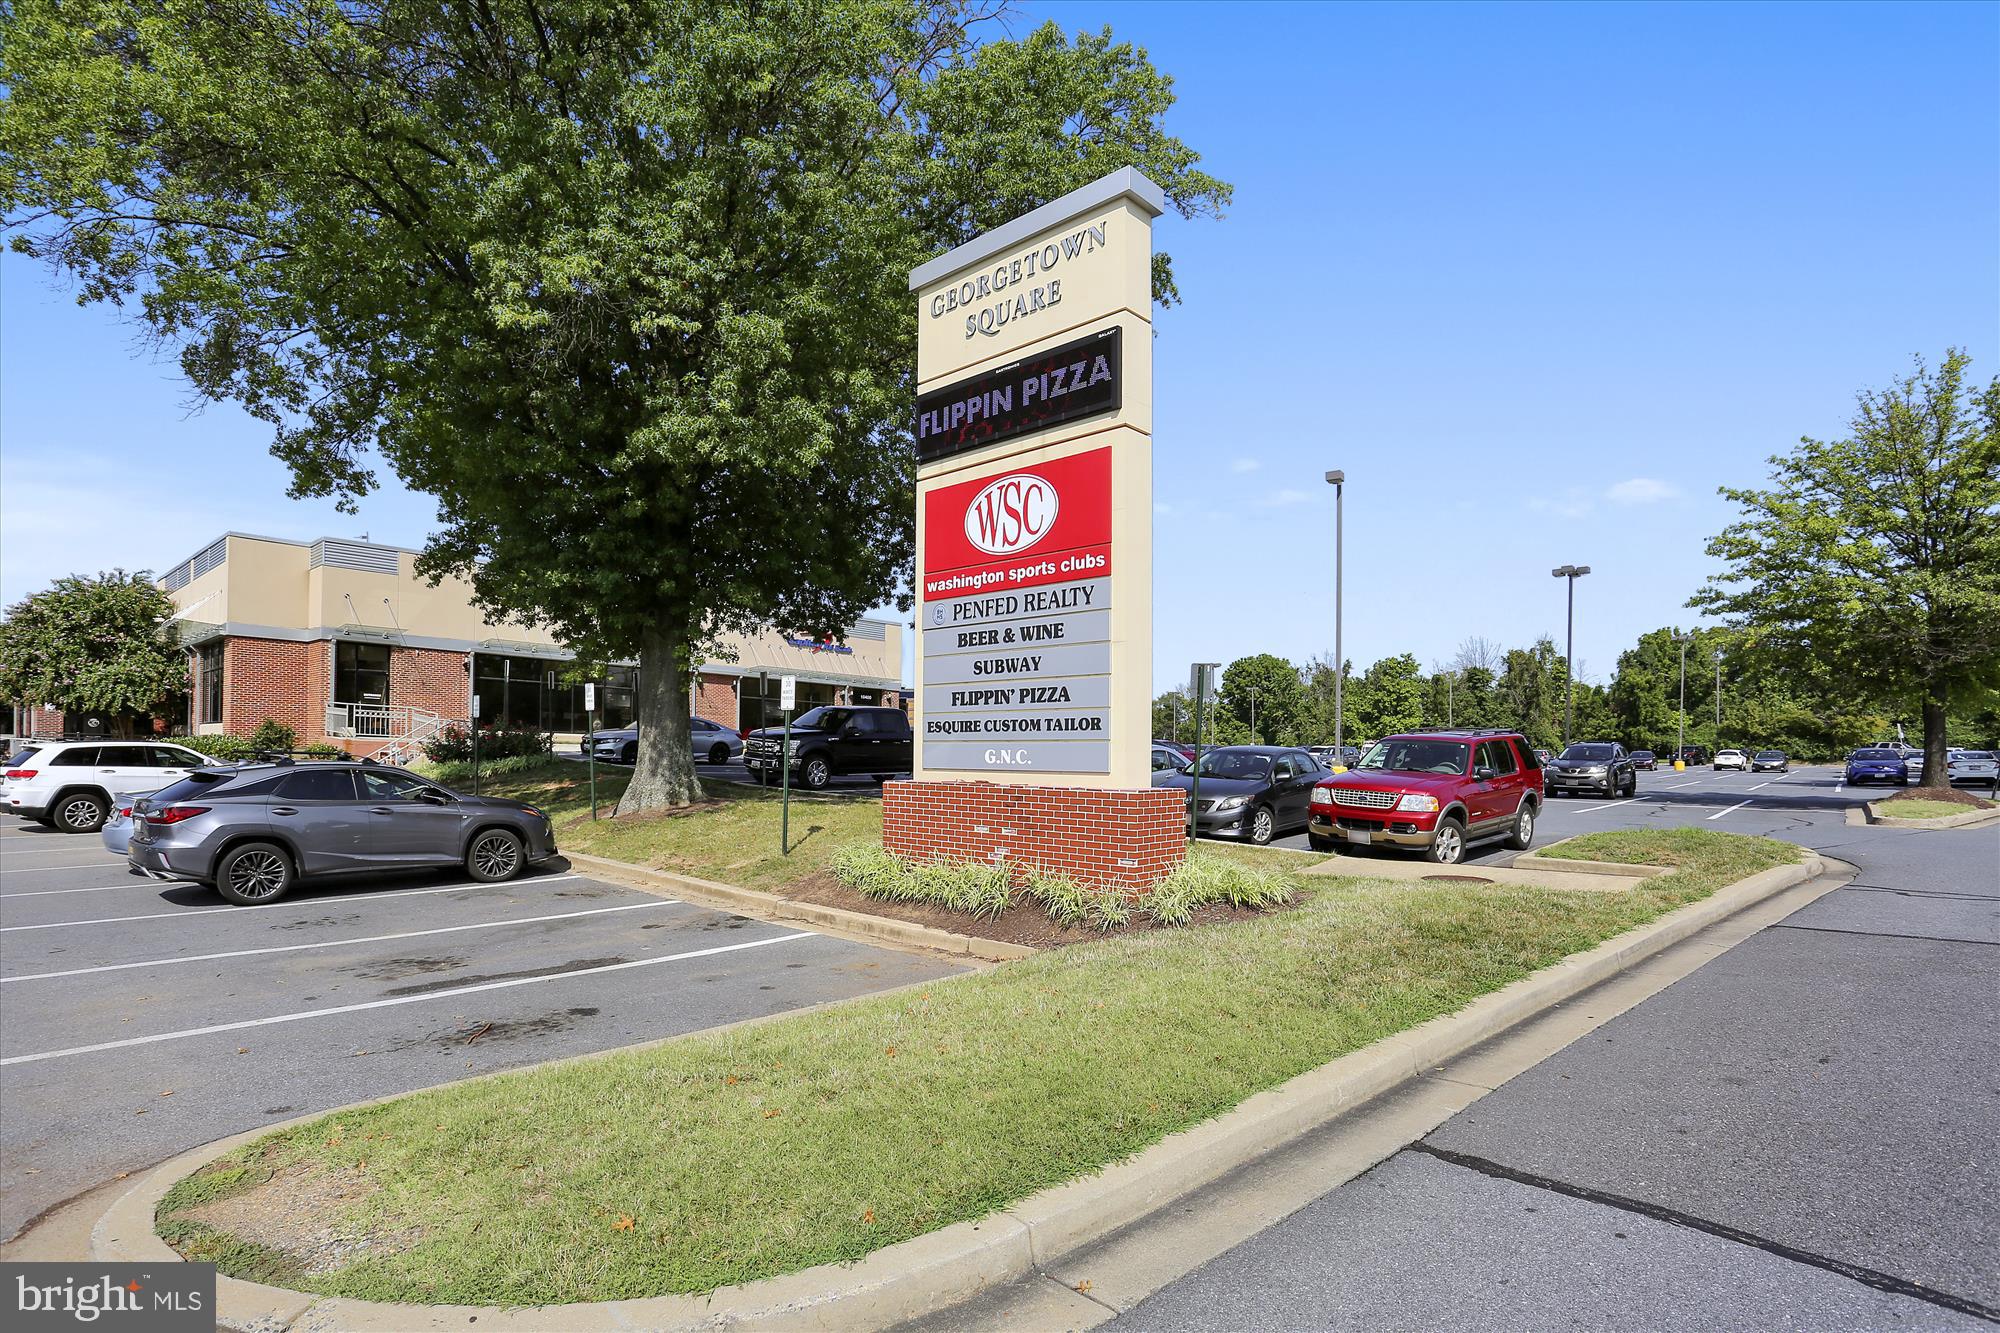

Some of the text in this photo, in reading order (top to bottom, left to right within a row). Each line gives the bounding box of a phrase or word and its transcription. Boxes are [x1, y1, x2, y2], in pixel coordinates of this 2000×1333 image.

[930, 221, 1107, 319] GEORGETOWN
[965, 280, 1062, 340] SQUARE
[920, 354, 1112, 438] FLIPPIN PIZZA
[975, 481, 1043, 548] WSC
[927, 553, 1105, 593] washington sports clubs
[952, 585, 1095, 621] PENFED REALTY
[957, 623, 1064, 648] BEER & WINE
[973, 656, 1042, 675] SUBWAY
[951, 686, 1071, 707] FLIPPIN' PIZZA
[927, 717, 1102, 735] ESQUIRE CUSTOM TAILOR
[984, 749, 1032, 765] G.N.C.
